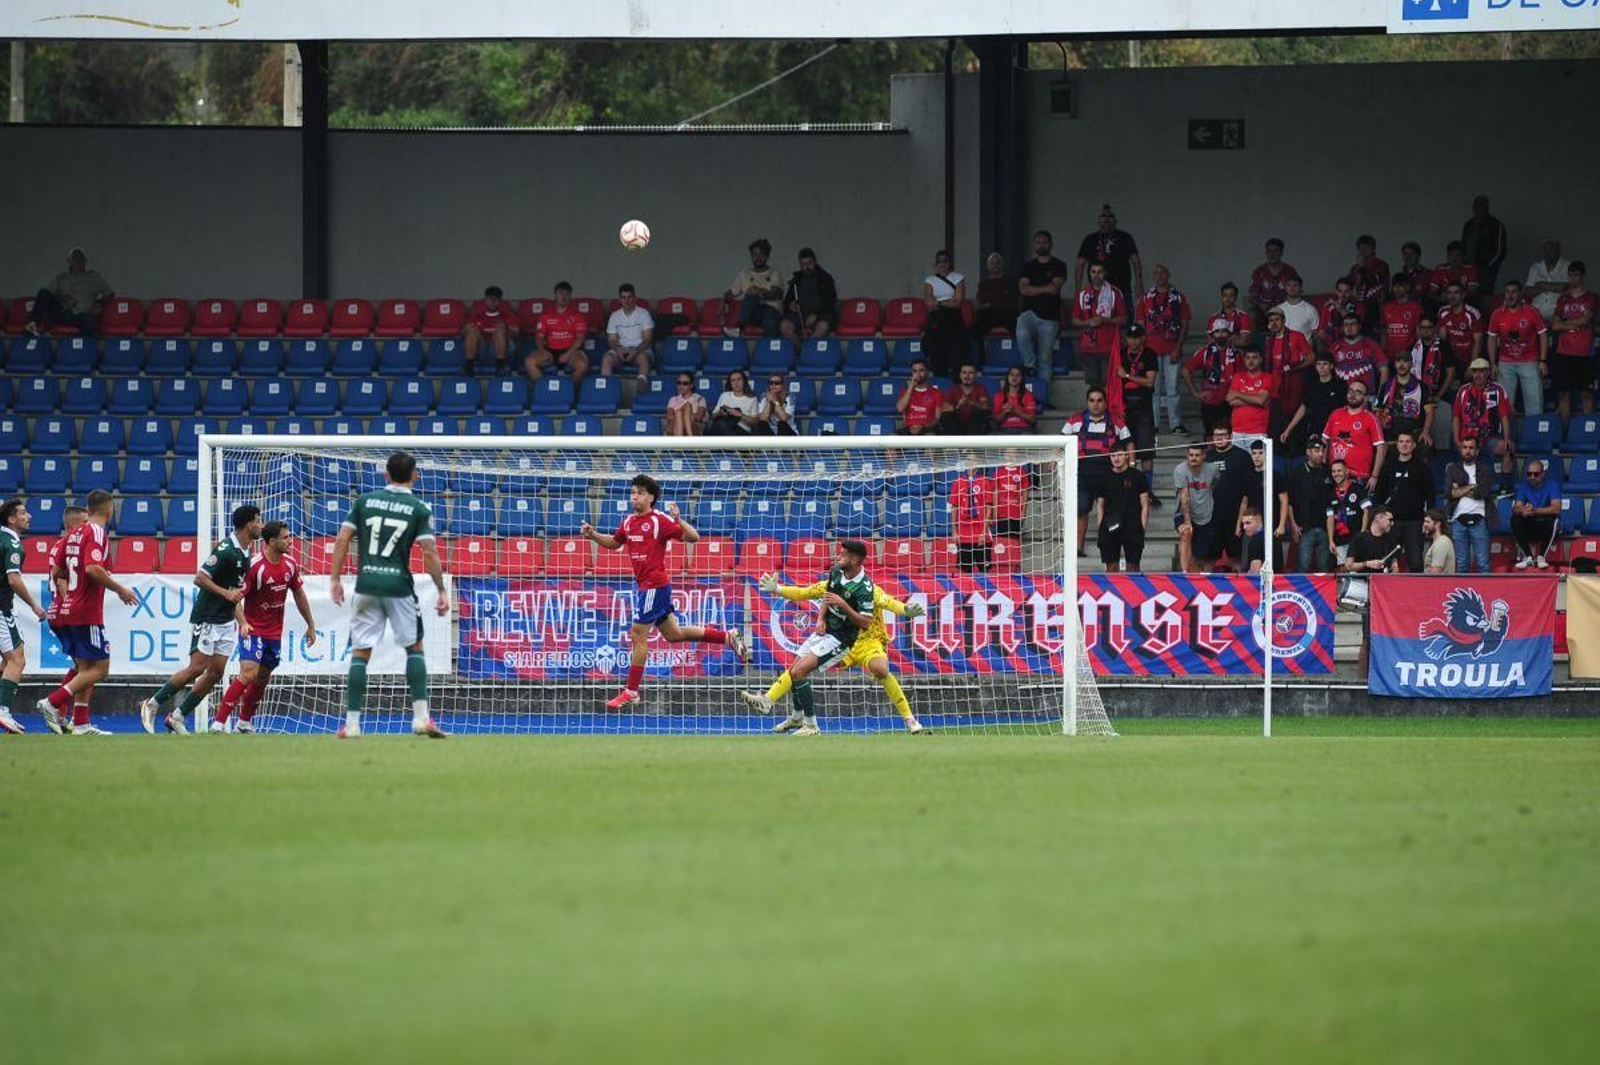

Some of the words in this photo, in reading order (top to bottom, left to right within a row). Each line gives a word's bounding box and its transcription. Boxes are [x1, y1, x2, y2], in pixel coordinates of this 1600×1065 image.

[365, 516, 409, 557] 17
[884, 590, 1236, 654] URENSE
[129, 629, 181, 662] DE
[616, 649, 697, 669] ORENSE
[1395, 661, 1526, 687] TROULA
